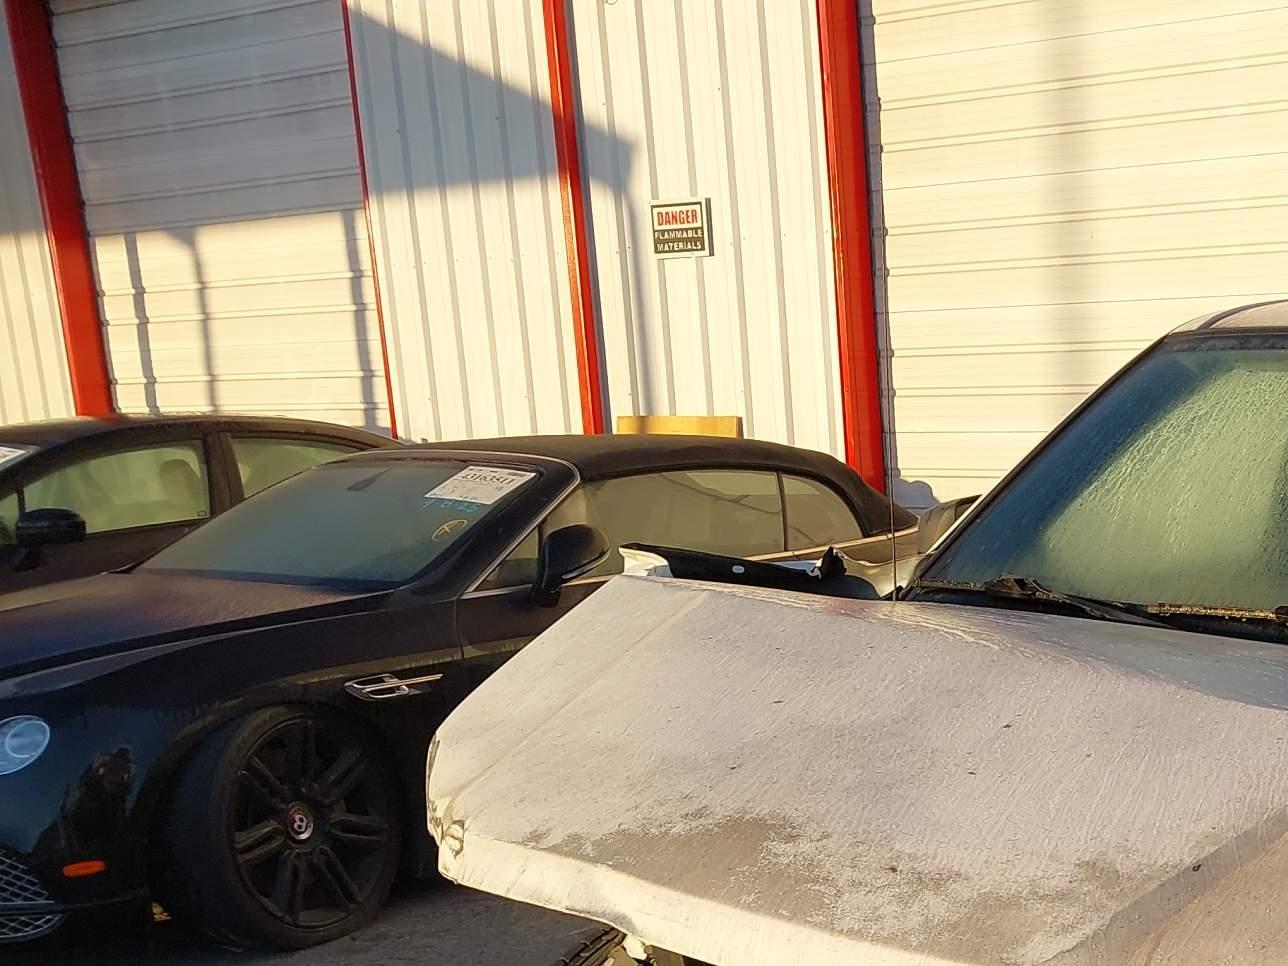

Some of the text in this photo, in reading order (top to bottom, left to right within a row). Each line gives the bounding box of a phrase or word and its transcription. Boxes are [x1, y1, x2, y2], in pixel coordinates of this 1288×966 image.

[657, 209, 698, 226] DANGER
[655, 229, 702, 240] FLAMMABLE
[657, 241, 702, 252] MATERIALS
